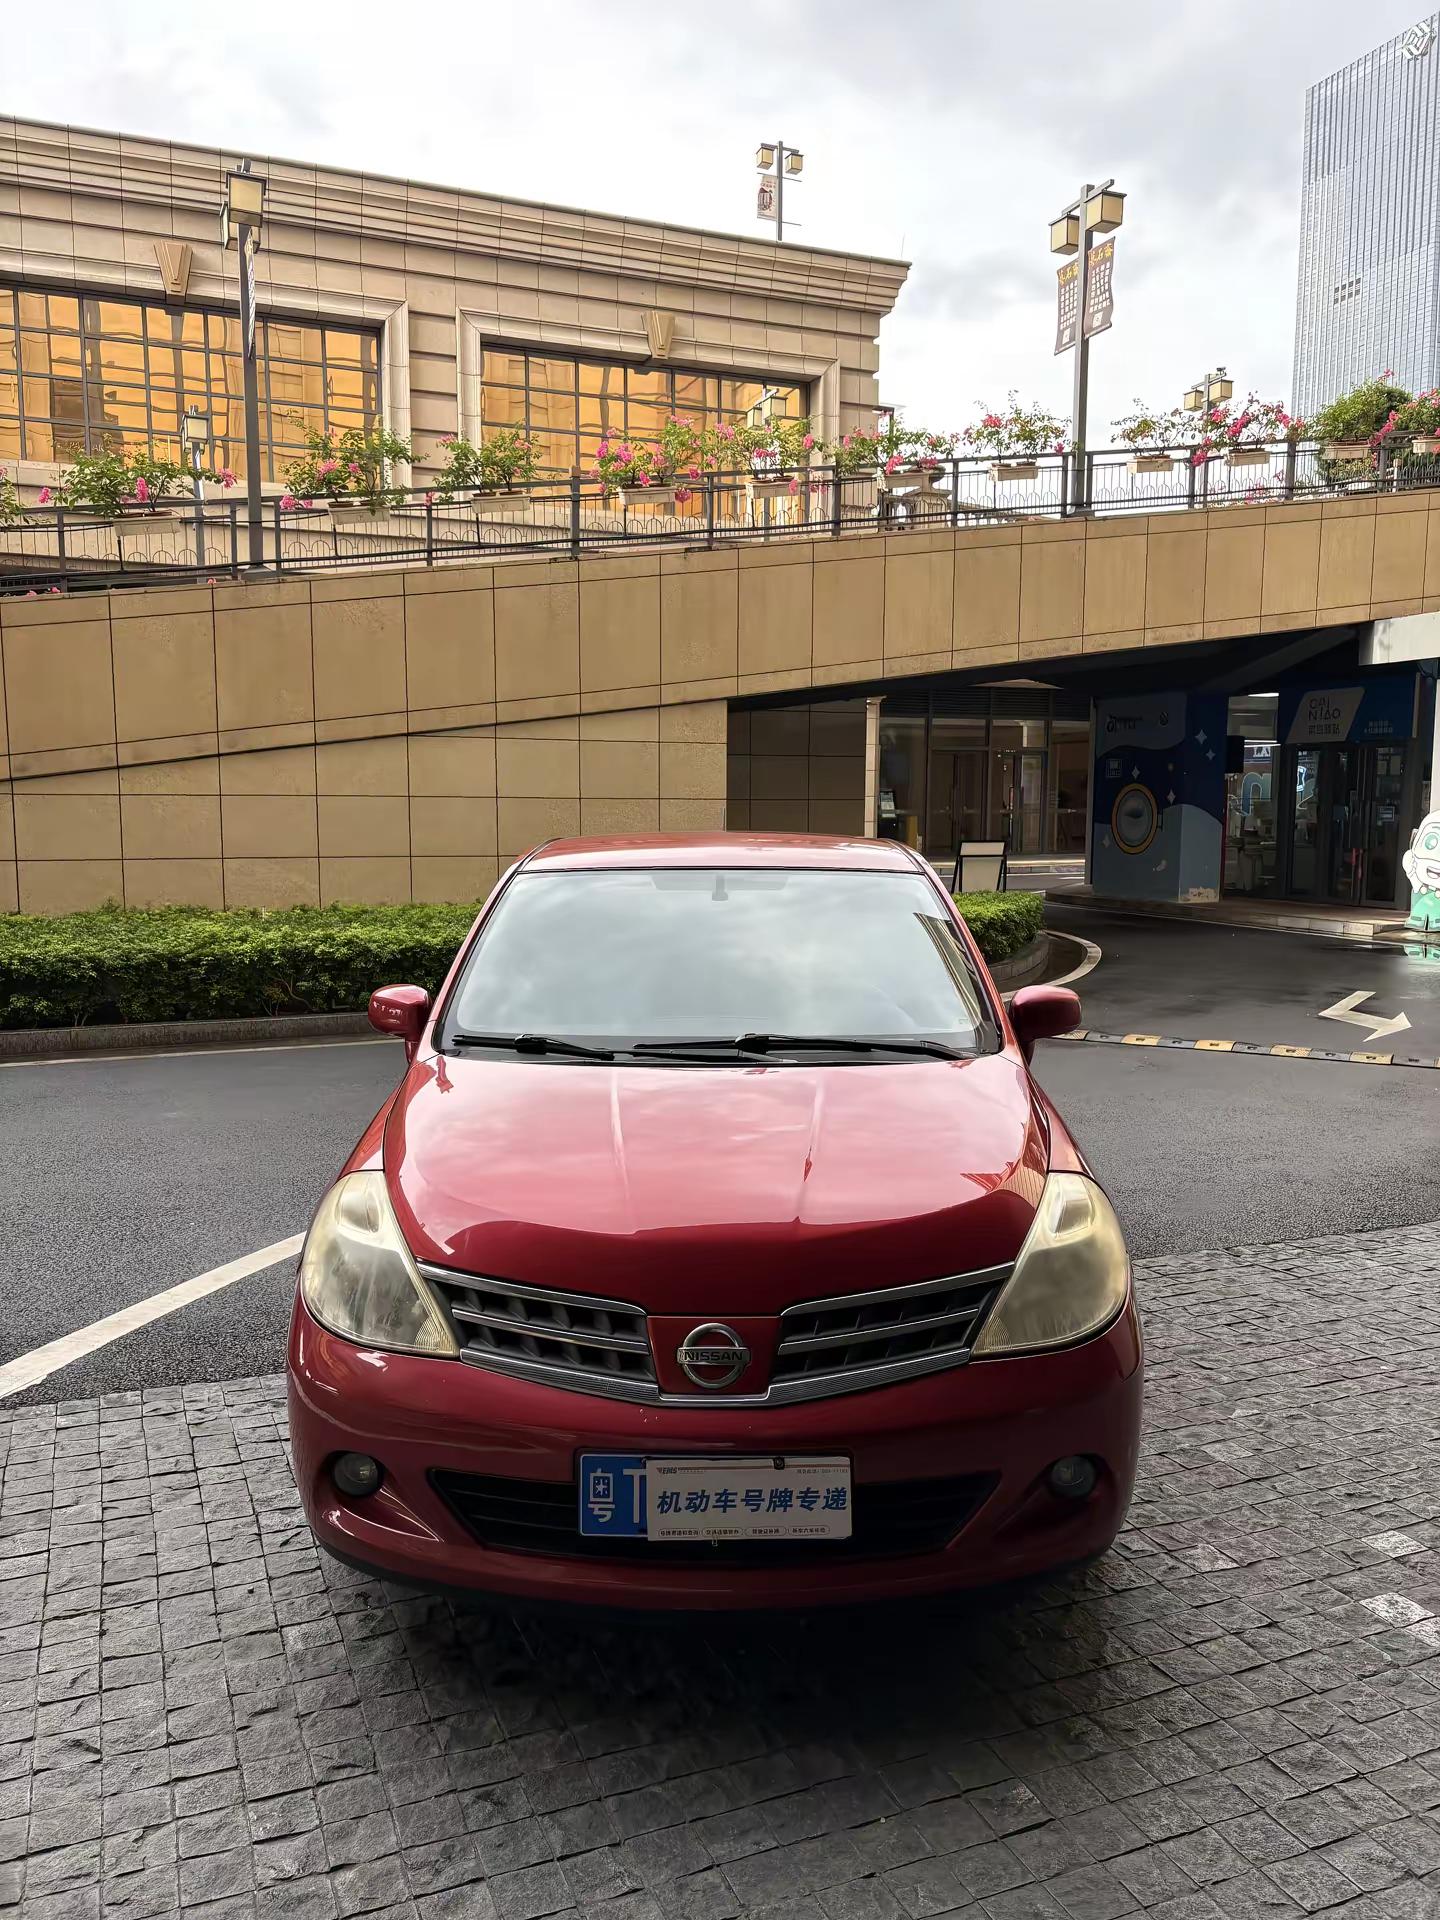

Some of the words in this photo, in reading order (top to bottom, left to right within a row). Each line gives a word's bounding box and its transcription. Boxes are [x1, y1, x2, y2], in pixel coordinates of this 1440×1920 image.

[1309, 696, 1330, 709] CAI
[1308, 707, 1341, 720] NIAO
[684, 1351, 743, 1361] NISSAN
[657, 1487, 848, 1514] 机动车号牌专递
